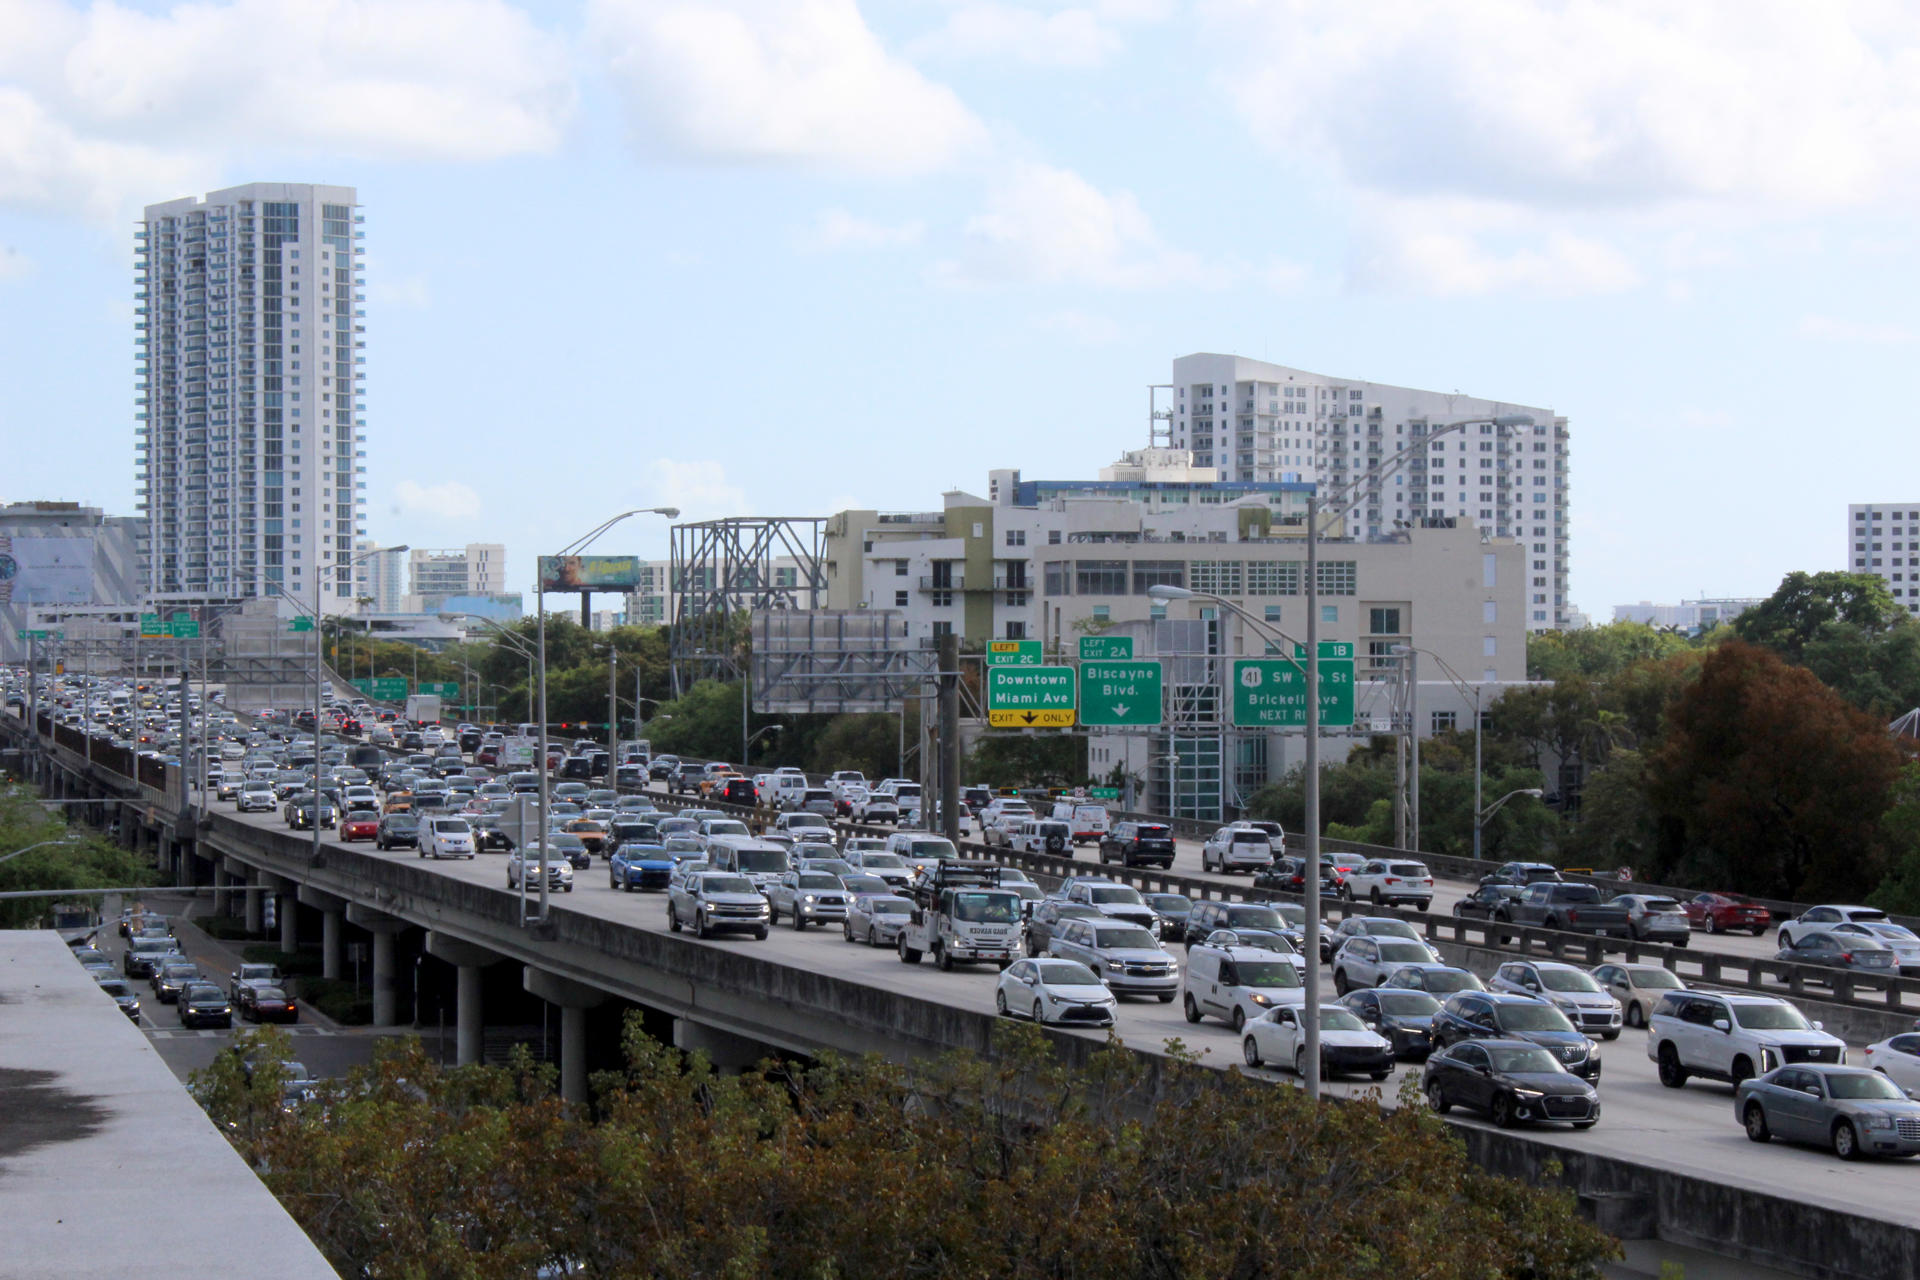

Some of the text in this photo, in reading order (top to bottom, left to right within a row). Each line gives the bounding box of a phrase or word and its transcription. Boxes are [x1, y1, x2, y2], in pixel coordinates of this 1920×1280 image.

[993, 643, 1016, 652] LEFT
[1084, 639, 1105, 647] LEFT
[1084, 646, 1128, 657] EXIT 2A
[1332, 645, 1347, 656] 1B
[995, 655, 1034, 664] EXIT 2C
[997, 674, 1067, 685] Downtown
[1087, 668, 1154, 681] Biscayne
[1245, 671, 1258, 683] 41
[1272, 672, 1293, 683] SW
[1331, 671, 1347, 683] St
[1103, 684, 1139, 696] Blvd.
[995, 692, 1069, 703] Miami Ave
[1248, 694, 1305, 705] Brickell
[991, 713, 1072, 723] EXIT ONLY
[1259, 709, 1328, 720] NEXT RIT
